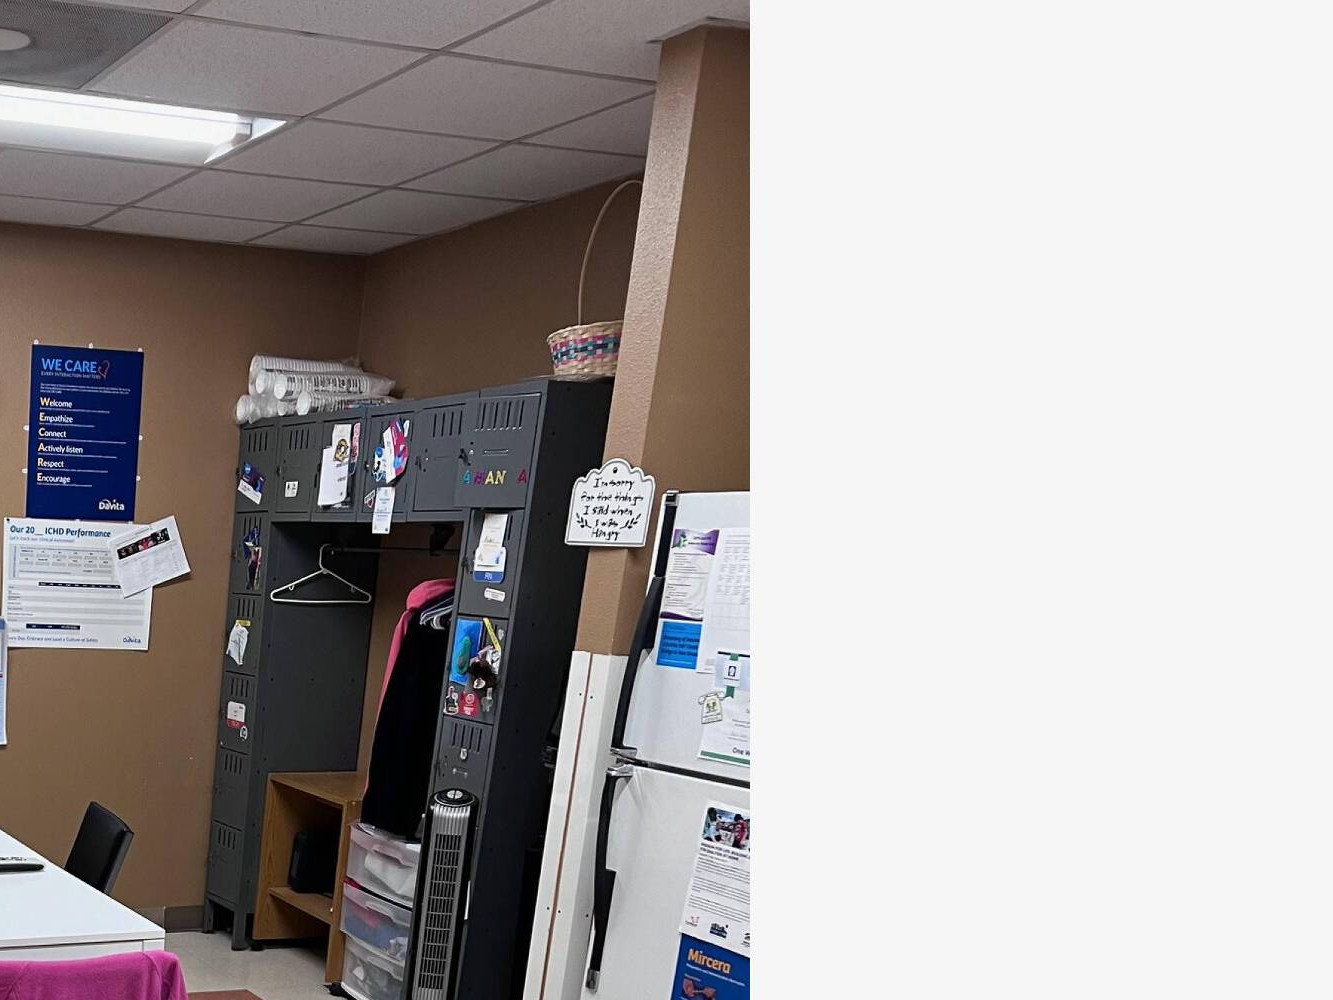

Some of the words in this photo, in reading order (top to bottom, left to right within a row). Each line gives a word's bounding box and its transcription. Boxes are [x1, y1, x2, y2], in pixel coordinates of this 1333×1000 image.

[41, 358, 63, 371] WE
[64, 359, 98, 373] CARE
[39, 397, 73, 408] Welcome
[39, 412, 74, 424] Empathize
[38, 427, 67, 438] Connect
[37, 442, 66, 454] Actively
[66, 445, 83, 454] listen
[37, 457, 65, 468] Respect
[36, 472, 71, 484] Encourage
[10, 525, 24, 534] Our
[45, 527, 64, 536] ICHD
[66, 527, 111, 539] Performance
[688, 947, 731, 974] Mircera
